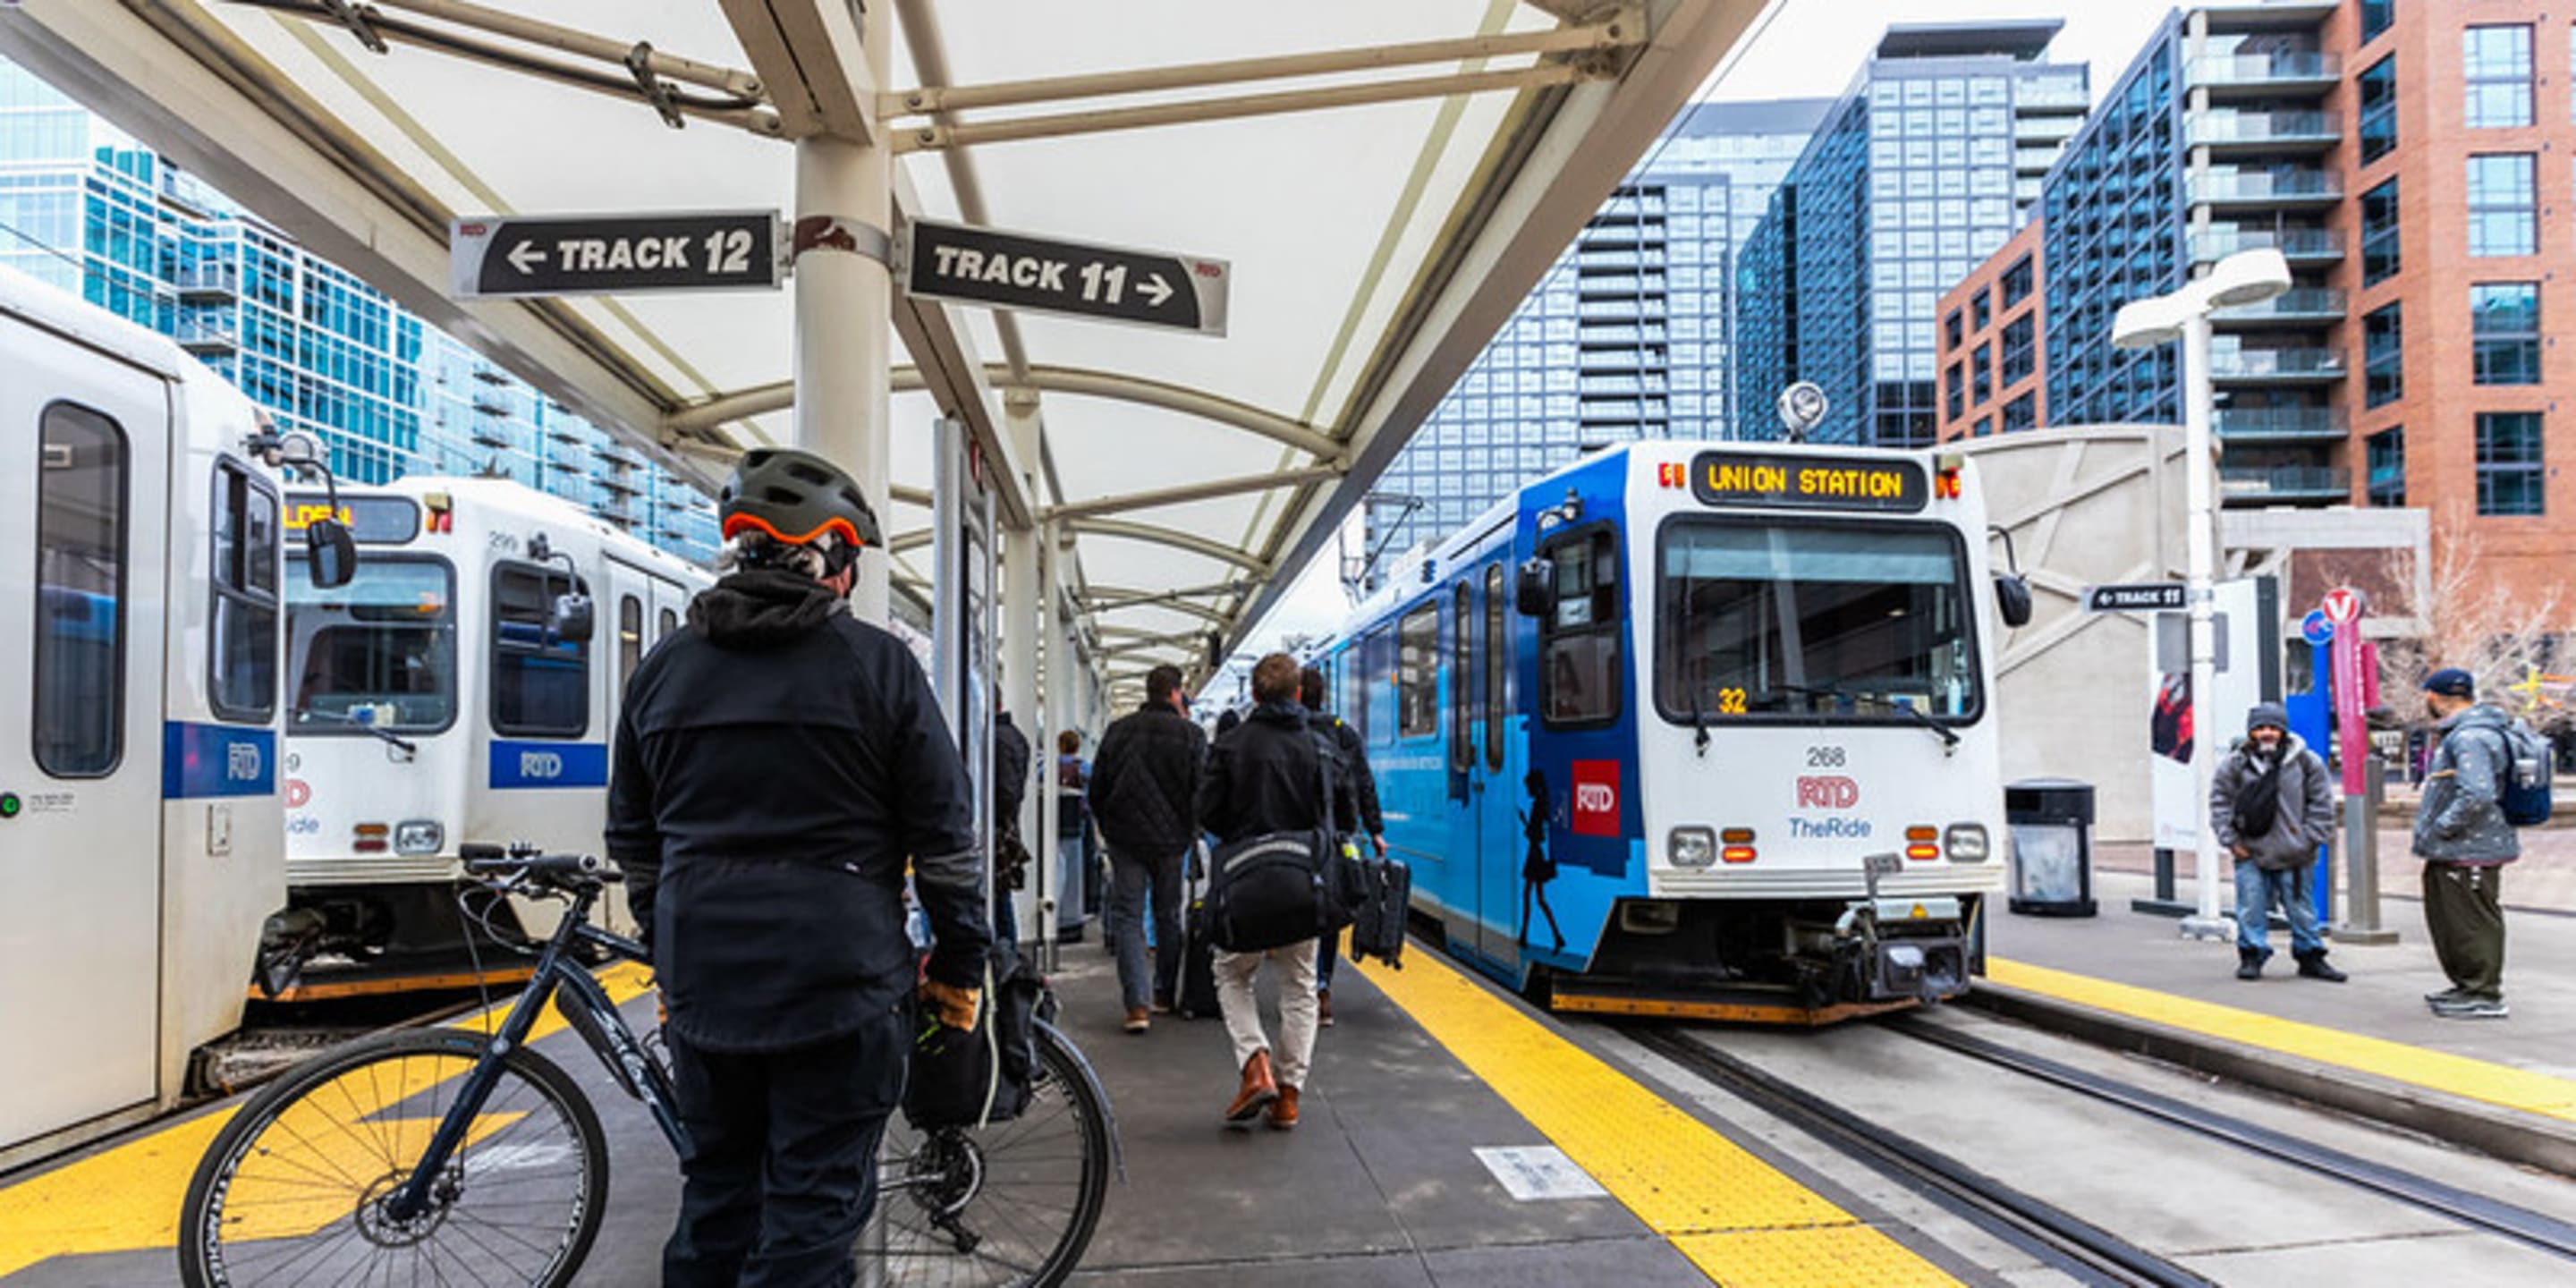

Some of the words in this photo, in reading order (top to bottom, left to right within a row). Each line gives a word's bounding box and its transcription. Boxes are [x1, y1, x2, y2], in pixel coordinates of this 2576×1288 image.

[556, 237, 691, 271] TRACK
[704, 229, 753, 274] 12
[934, 245, 1069, 292] TRACK
[1080, 262, 1128, 303] 11
[1708, 464, 1787, 492] UNION
[1798, 469, 1902, 497] STATION
[2115, 591, 2160, 603] TRACK
[2164, 589, 2181, 603] 11
[1718, 688, 1747, 714] 32
[521, 751, 563, 777] RTD
[1807, 746, 1846, 767] 268
[1577, 784, 1614, 812] RTD
[1797, 775, 1859, 809] RTD
[1790, 818, 1872, 838] TheRide
